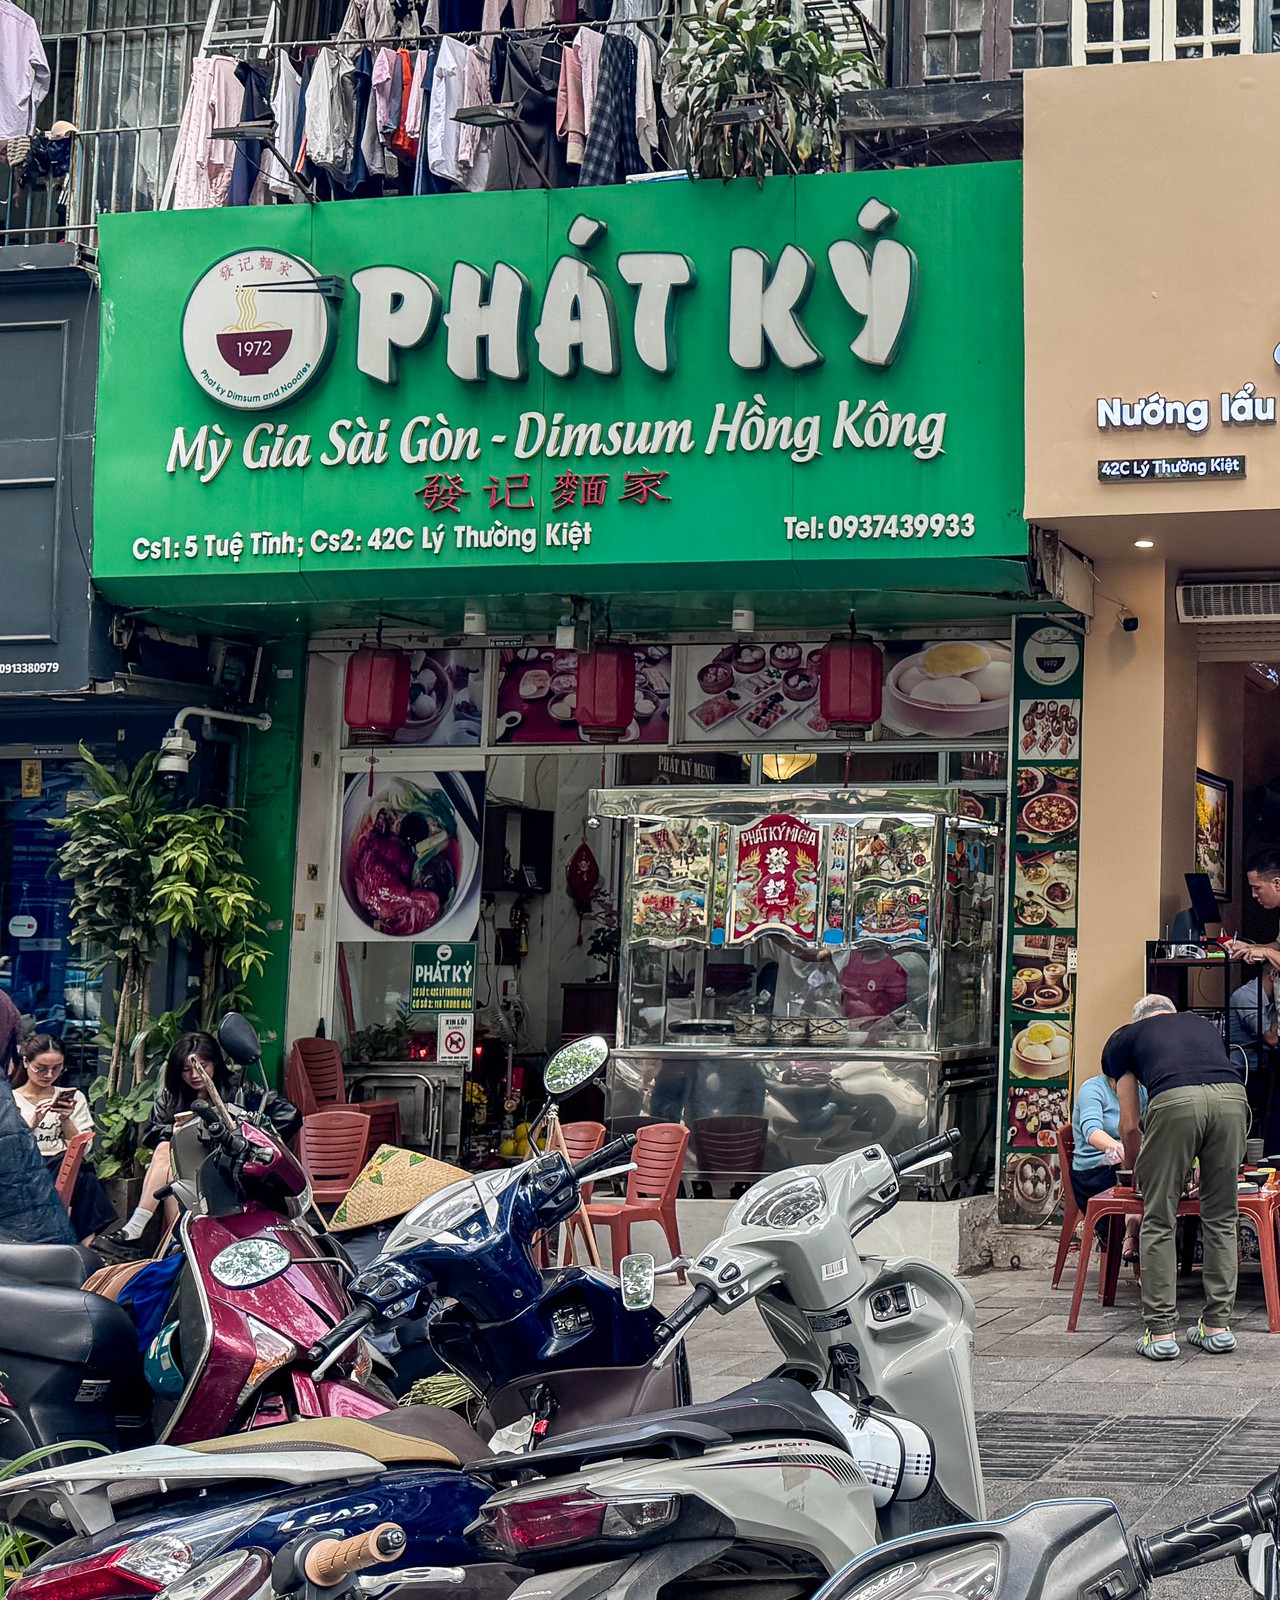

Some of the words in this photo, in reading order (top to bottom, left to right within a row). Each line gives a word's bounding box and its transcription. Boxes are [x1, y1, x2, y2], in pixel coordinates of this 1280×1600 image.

[350, 213, 697, 385] PHÁT
[729, 197, 917, 370] KÝ
[237, 341, 272, 357] 1972
[226, 389, 261, 402] Dimsum
[262, 388, 280, 401] and
[280, 362, 311, 394] Noodles
[1096, 391, 1209, 431] Nướng
[1220, 382, 1276, 424] lẩu
[166, 423, 233, 483] Mỳ
[243, 422, 312, 470] Gia
[320, 416, 392, 467] Sài
[401, 411, 482, 465] Gòn
[514, 410, 695, 460] Dimsum
[704, 394, 823, 462] Hồng
[832, 399, 947, 460] Kông
[1101, 461, 1131, 476] 42C
[1133, 459, 1150, 478] Lý
[1153, 459, 1207, 477] Thường
[1211, 457, 1240, 475] Kiệt
[132, 536, 181, 561] Cs1:
[184, 535, 198, 557] 5
[204, 532, 243, 563] Tuệ
[250, 531, 304, 559] Tĩnh;
[310, 528, 362, 553] Cs2:
[367, 528, 414, 551] 42C
[421, 524, 445, 555] Lý
[454, 519, 537, 553] Thường
[546, 518, 592, 552] Kiệt
[784, 515, 824, 540] Tel:
[828, 512, 975, 539] 0937439933
[415, 960, 451, 983] PHÁT
[452, 960, 472, 983] KÝ
[738, 1442, 811, 1451] VISION
[278, 1503, 378, 1533] LEAD
